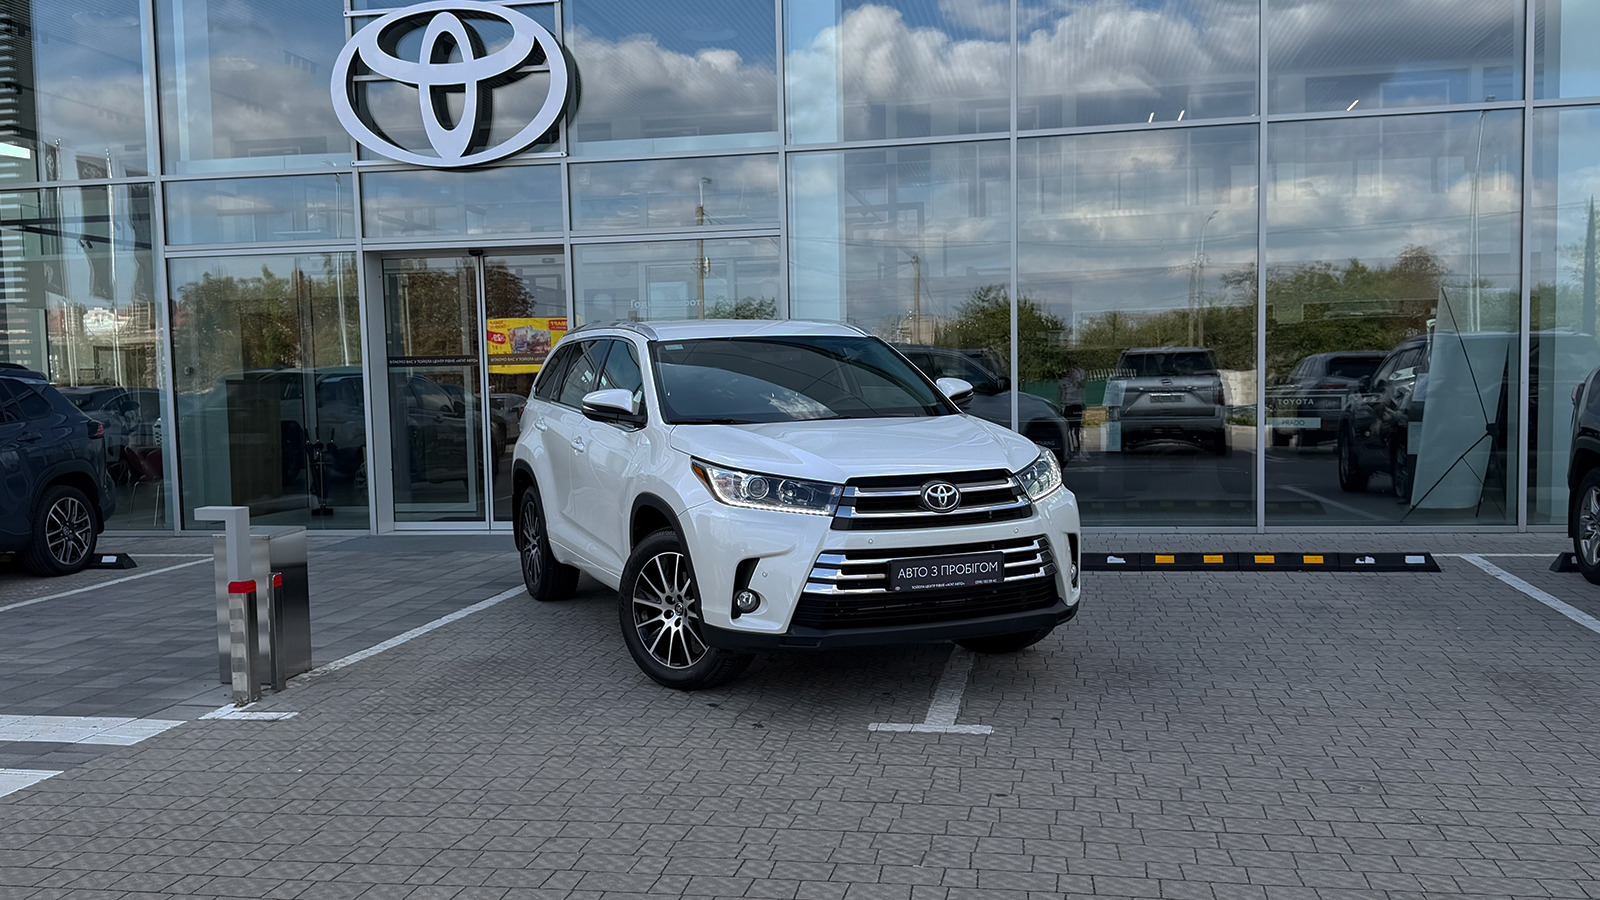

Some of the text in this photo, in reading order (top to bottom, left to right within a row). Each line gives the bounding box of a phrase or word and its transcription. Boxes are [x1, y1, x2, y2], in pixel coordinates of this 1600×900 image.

[898, 561, 998, 579] АВТО З ПРОБІГОМ
